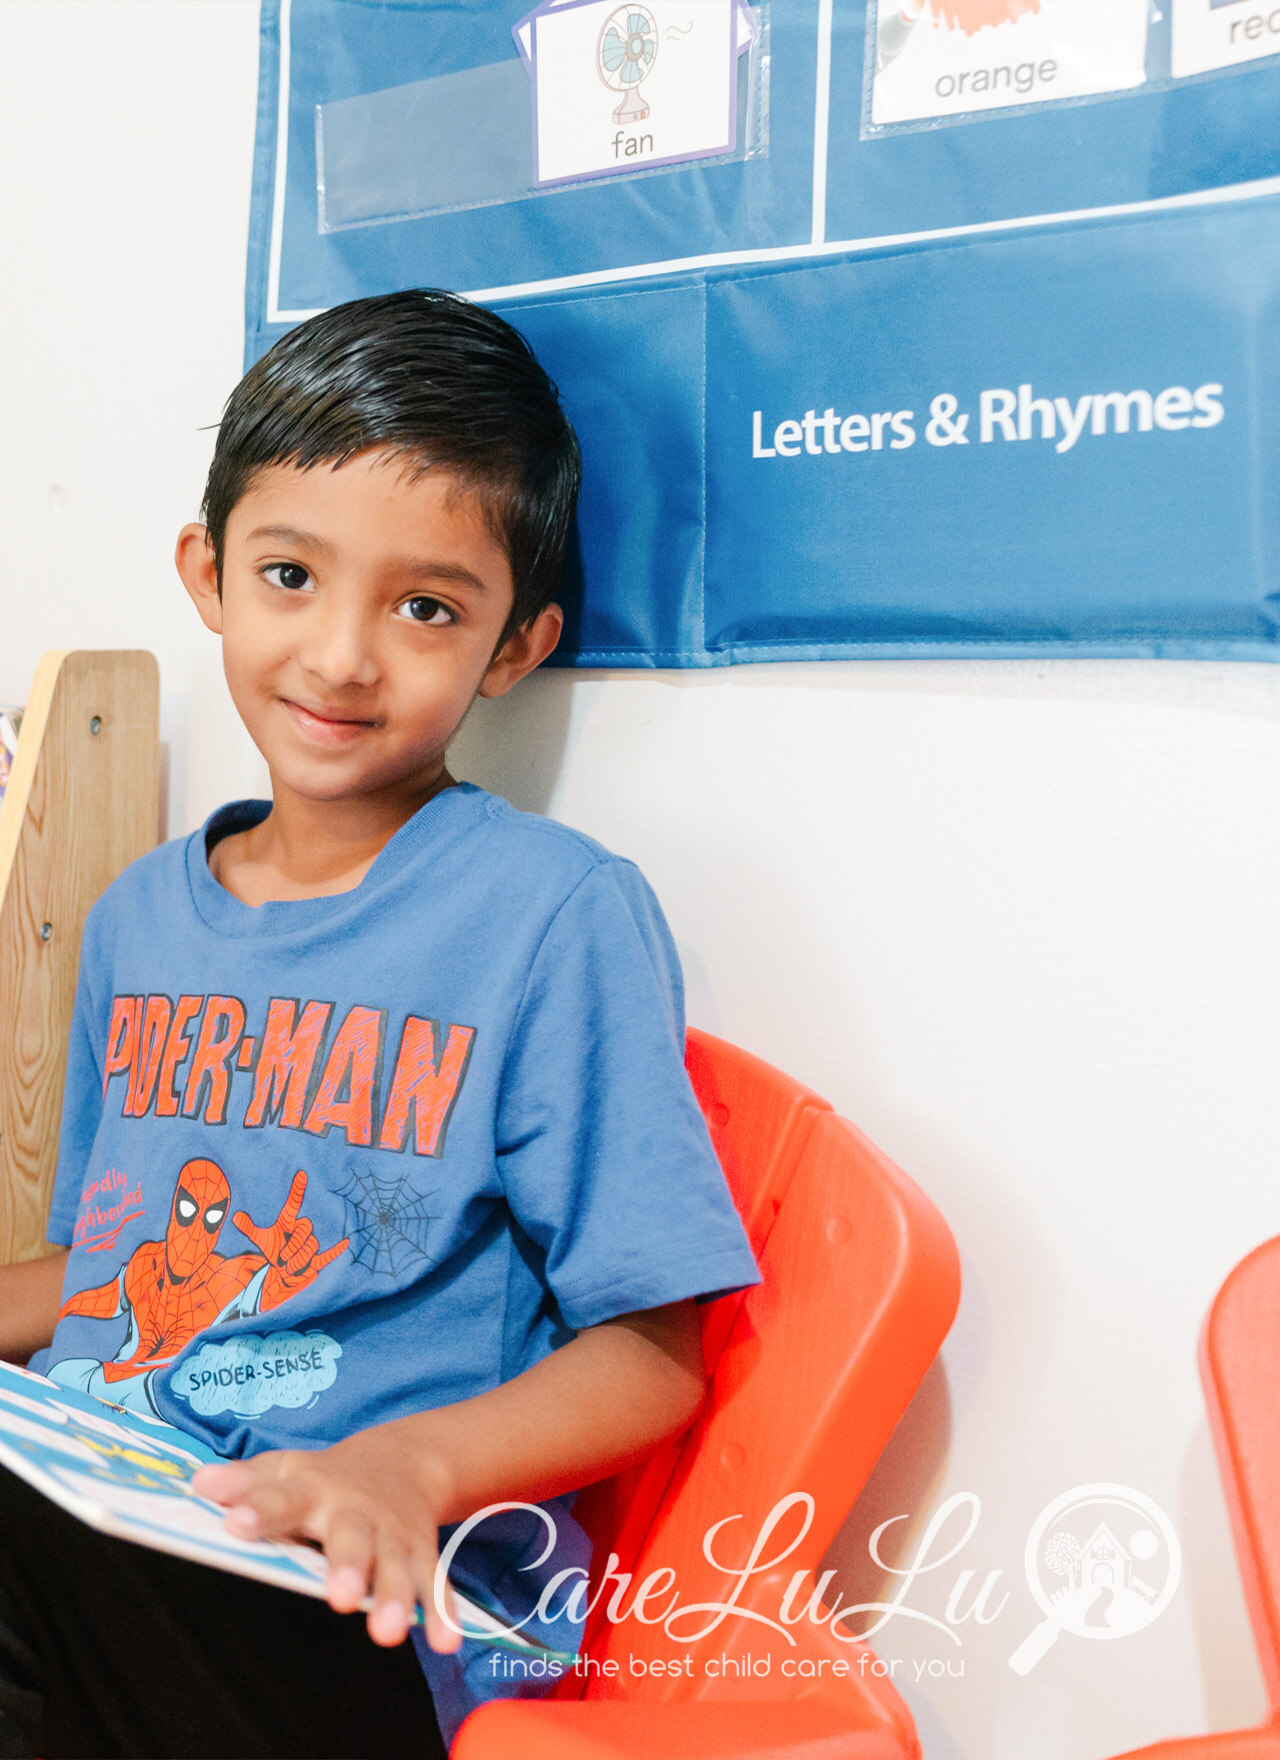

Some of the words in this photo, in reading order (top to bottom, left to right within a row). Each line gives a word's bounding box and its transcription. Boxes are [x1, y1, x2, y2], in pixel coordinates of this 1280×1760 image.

[935, 59, 1058, 99] orange
[611, 127, 655, 160] fan
[752, 407, 917, 459] Letters
[924, 392, 970, 447] &
[978, 382, 1225, 454] Rhymes
[102, 993, 477, 1159] PIDER-MAN
[189, 1351, 323, 1391] SPIDER-SENSE
